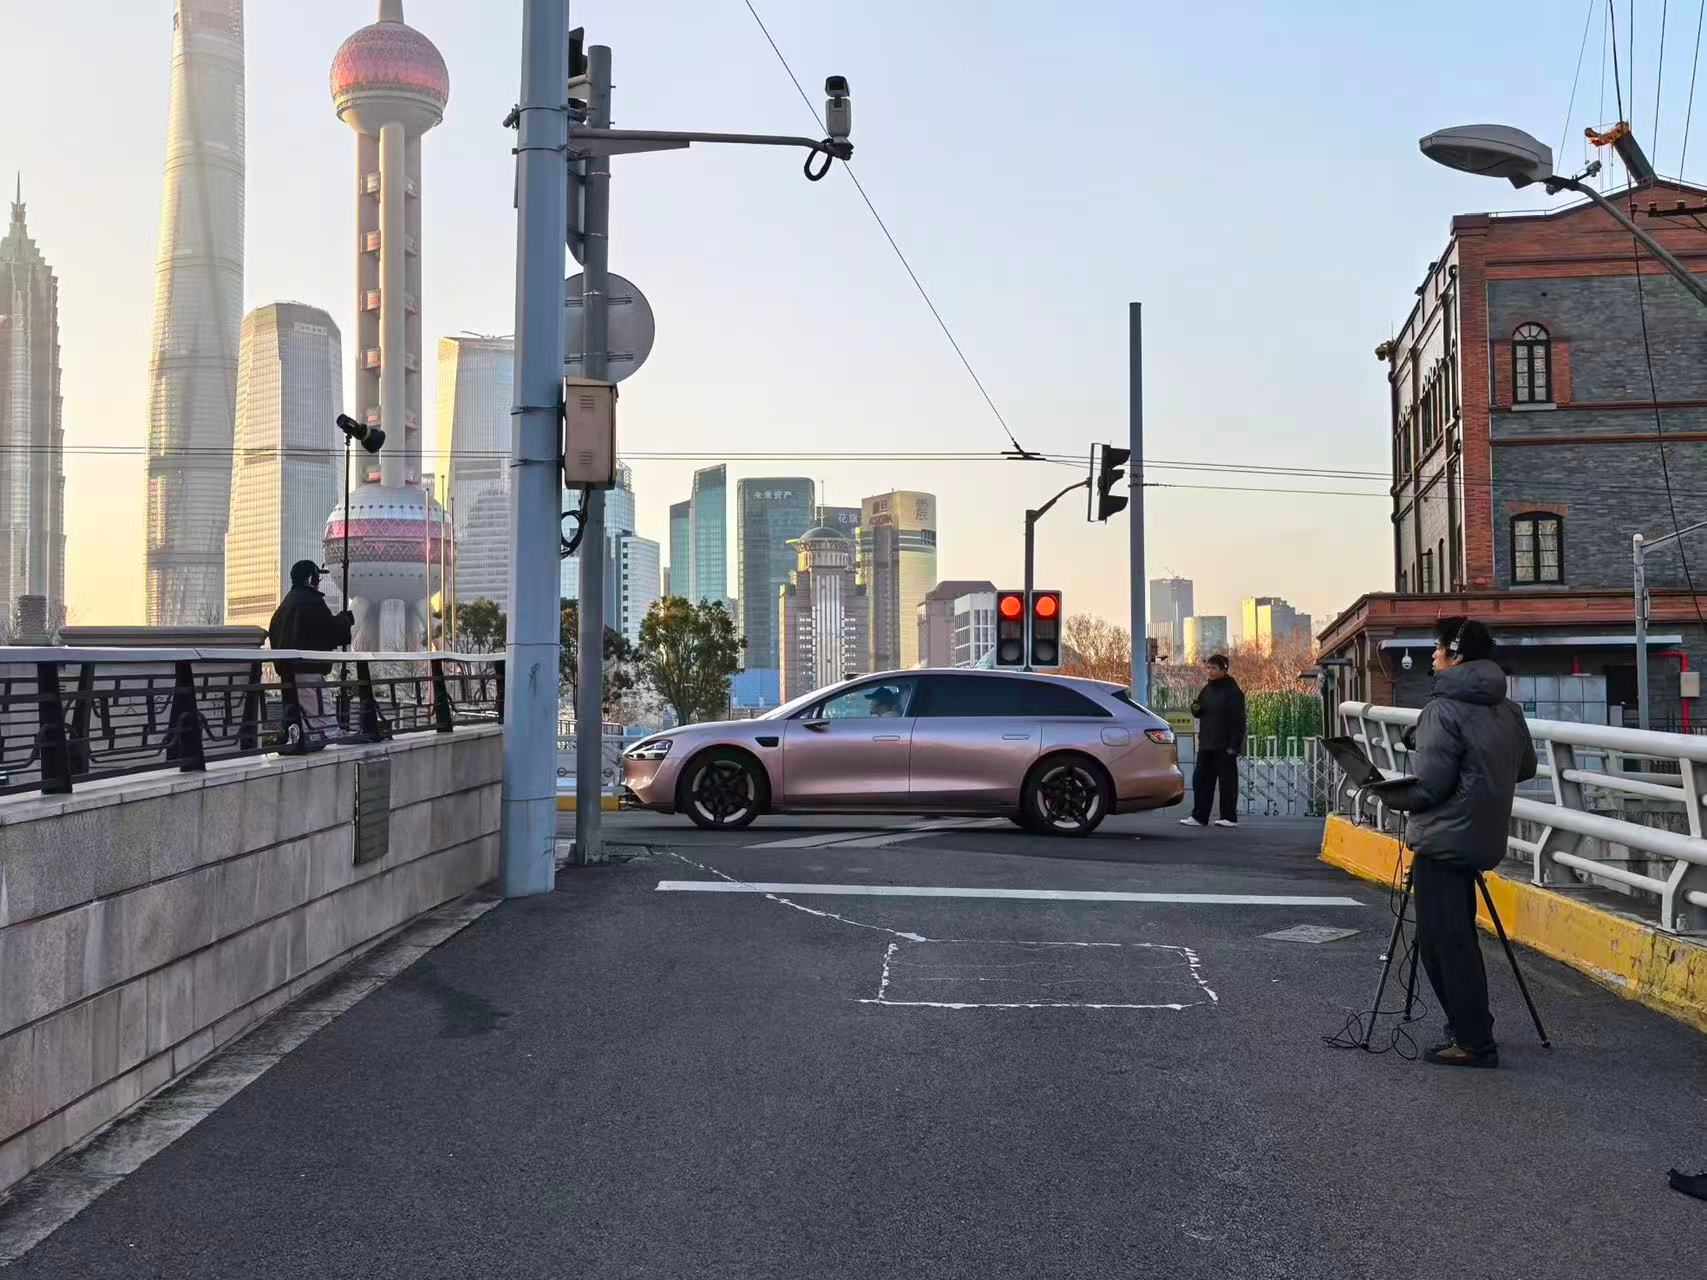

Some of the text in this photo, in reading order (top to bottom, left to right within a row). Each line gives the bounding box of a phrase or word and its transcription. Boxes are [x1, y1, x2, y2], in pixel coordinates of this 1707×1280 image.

[753, 490, 793, 500] 未来资产
[838, 511, 862, 524] 花旗
